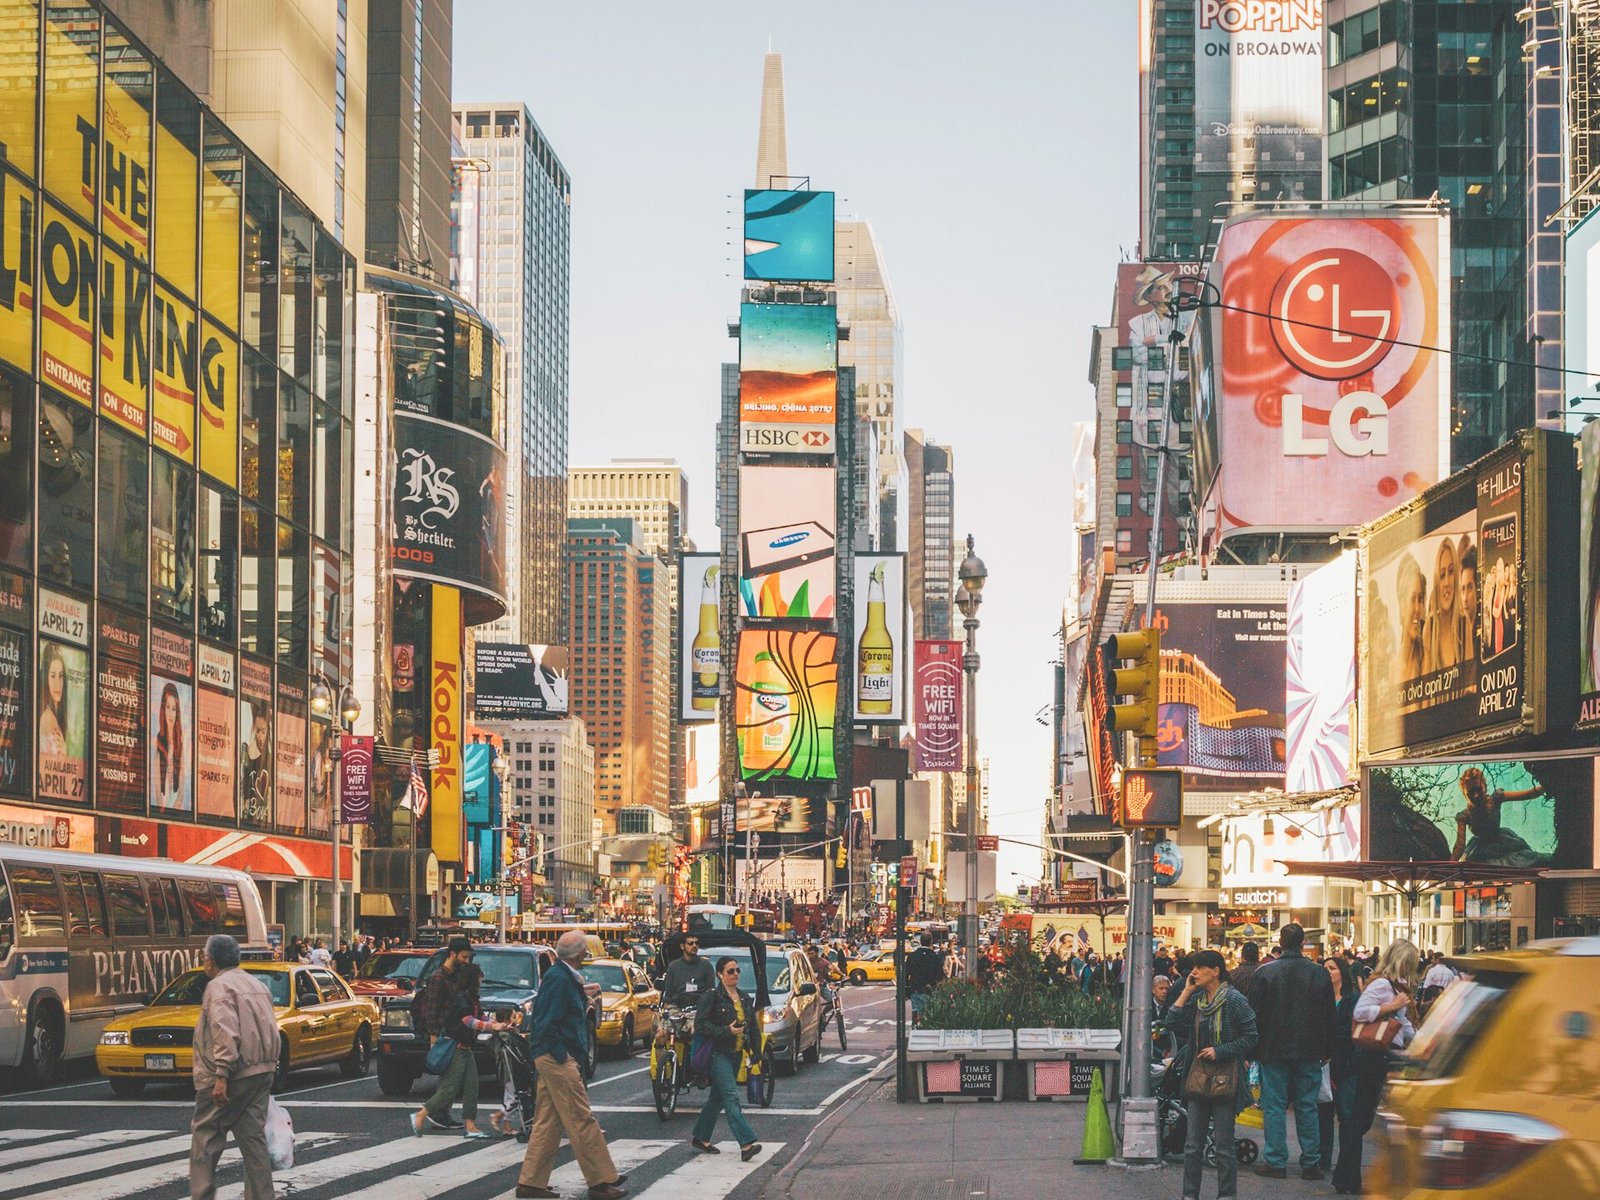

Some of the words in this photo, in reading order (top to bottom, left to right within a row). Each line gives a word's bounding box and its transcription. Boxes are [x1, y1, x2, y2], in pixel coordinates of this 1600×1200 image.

[1204, 42, 1230, 56] ON
[77, 114, 148, 228] THE
[123, 241, 226, 411] KING
[45, 357, 91, 396] ENTRANCE
[103, 391, 118, 412] ON
[122, 403, 144, 426] 45TH
[153, 415, 178, 445] STREET
[781, 403, 807, 412] CHINA
[1282, 391, 1389, 457] LG
[746, 429, 800, 446] HSBC
[1477, 479, 1490, 497] THE
[1489, 462, 1521, 499] HILLS
[1496, 523, 1515, 543] HILLS
[9, 596, 23, 610] FLY
[46, 597, 81, 618] AVAILABLE
[1217, 609, 1231, 619] Eat
[1243, 609, 1268, 619] Times
[42, 611, 70, 635] APRIL
[72, 620, 84, 639] 27
[1257, 622, 1272, 631] Let
[101, 624, 128, 643] SPARKS
[127, 631, 140, 648] FLY
[152, 631, 190, 656] miranda
[1235, 634, 1248, 642] Visit
[151, 649, 190, 671] cosgrove
[695, 649, 719, 658] Coron
[99, 668, 138, 692] miranda
[201, 662, 220, 681] APRIL
[222, 669, 231, 684] 27
[1481, 671, 1496, 694] ON
[1497, 665, 1517, 689] DVD
[98, 686, 139, 707] cosgrove
[923, 685, 956, 699] FREE
[1407, 681, 1423, 701] dvd
[1425, 674, 1443, 698] april
[925, 700, 954, 714] WIFI
[1479, 691, 1505, 716] APRIL
[1505, 687, 1518, 709] 27
[434, 661, 456, 790] Kodak
[919, 722, 937, 730] TIMES
[44, 759, 78, 774] AVAILABLE
[346, 764, 368, 775] FREE
[39, 772, 69, 796] APRIL
[71, 777, 85, 798] 27
[347, 775, 366, 785] WIFI
[1234, 890, 1278, 905] swatch
[1153, 926, 1175, 938] SON
[93, 949, 201, 997] PHANTOM
[961, 1073, 993, 1082] SQUARE
[964, 1065, 990, 1073] TIMES
